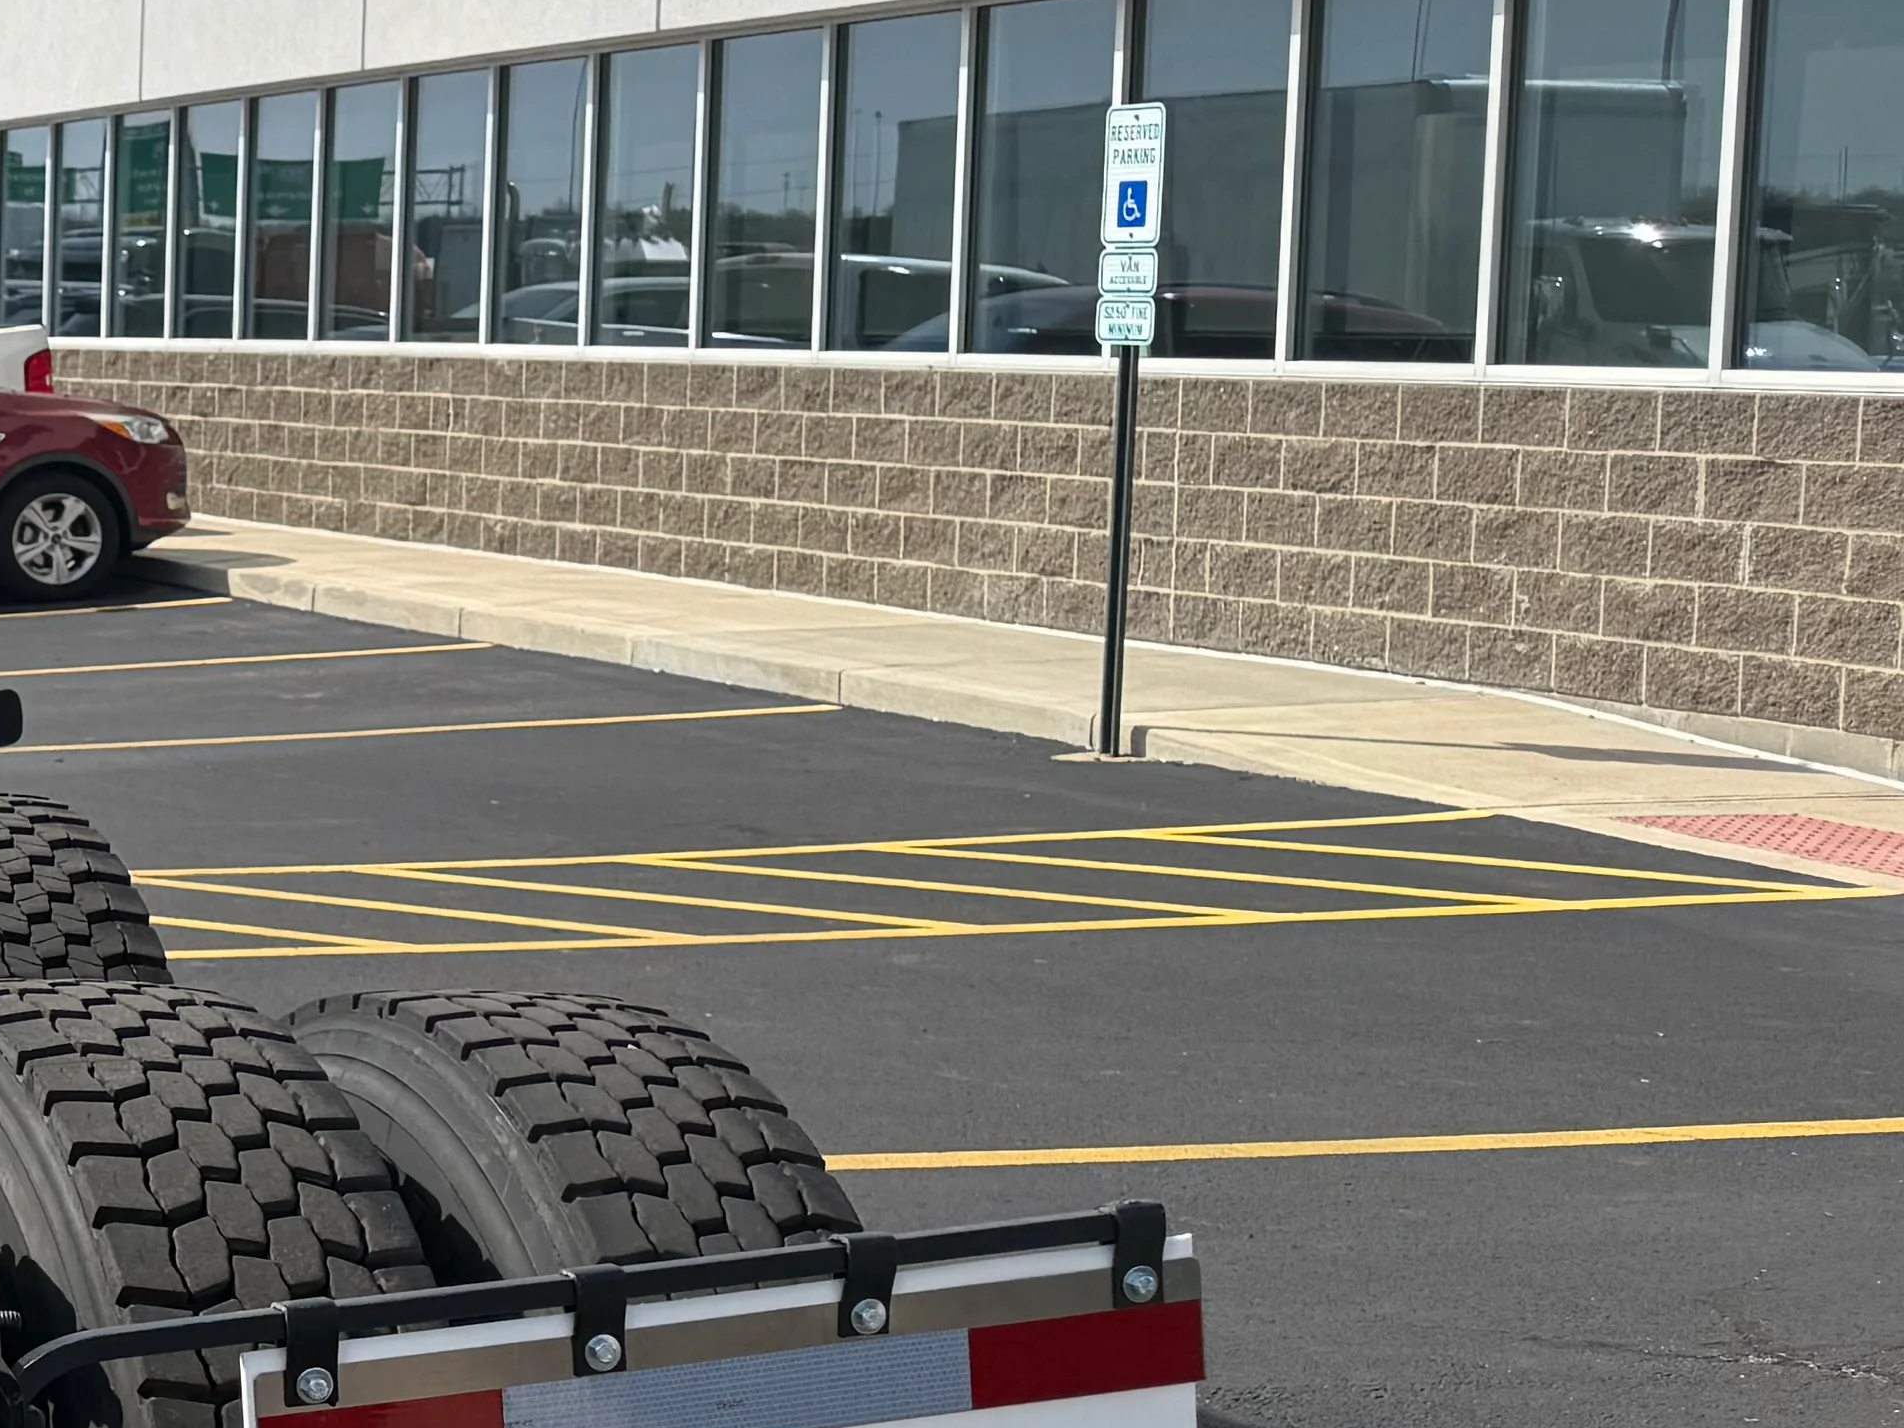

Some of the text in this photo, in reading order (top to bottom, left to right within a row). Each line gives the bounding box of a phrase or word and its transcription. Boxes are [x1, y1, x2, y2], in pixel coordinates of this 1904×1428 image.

[1110, 123, 1160, 141] RESERVED
[1113, 147, 1156, 164] PARKING
[1120, 259, 1140, 273] VAN
[1109, 275, 1147, 285] ACCESSIBLE
[1132, 306, 1148, 320] FINE
[1108, 323, 1143, 336] MINIMUM
